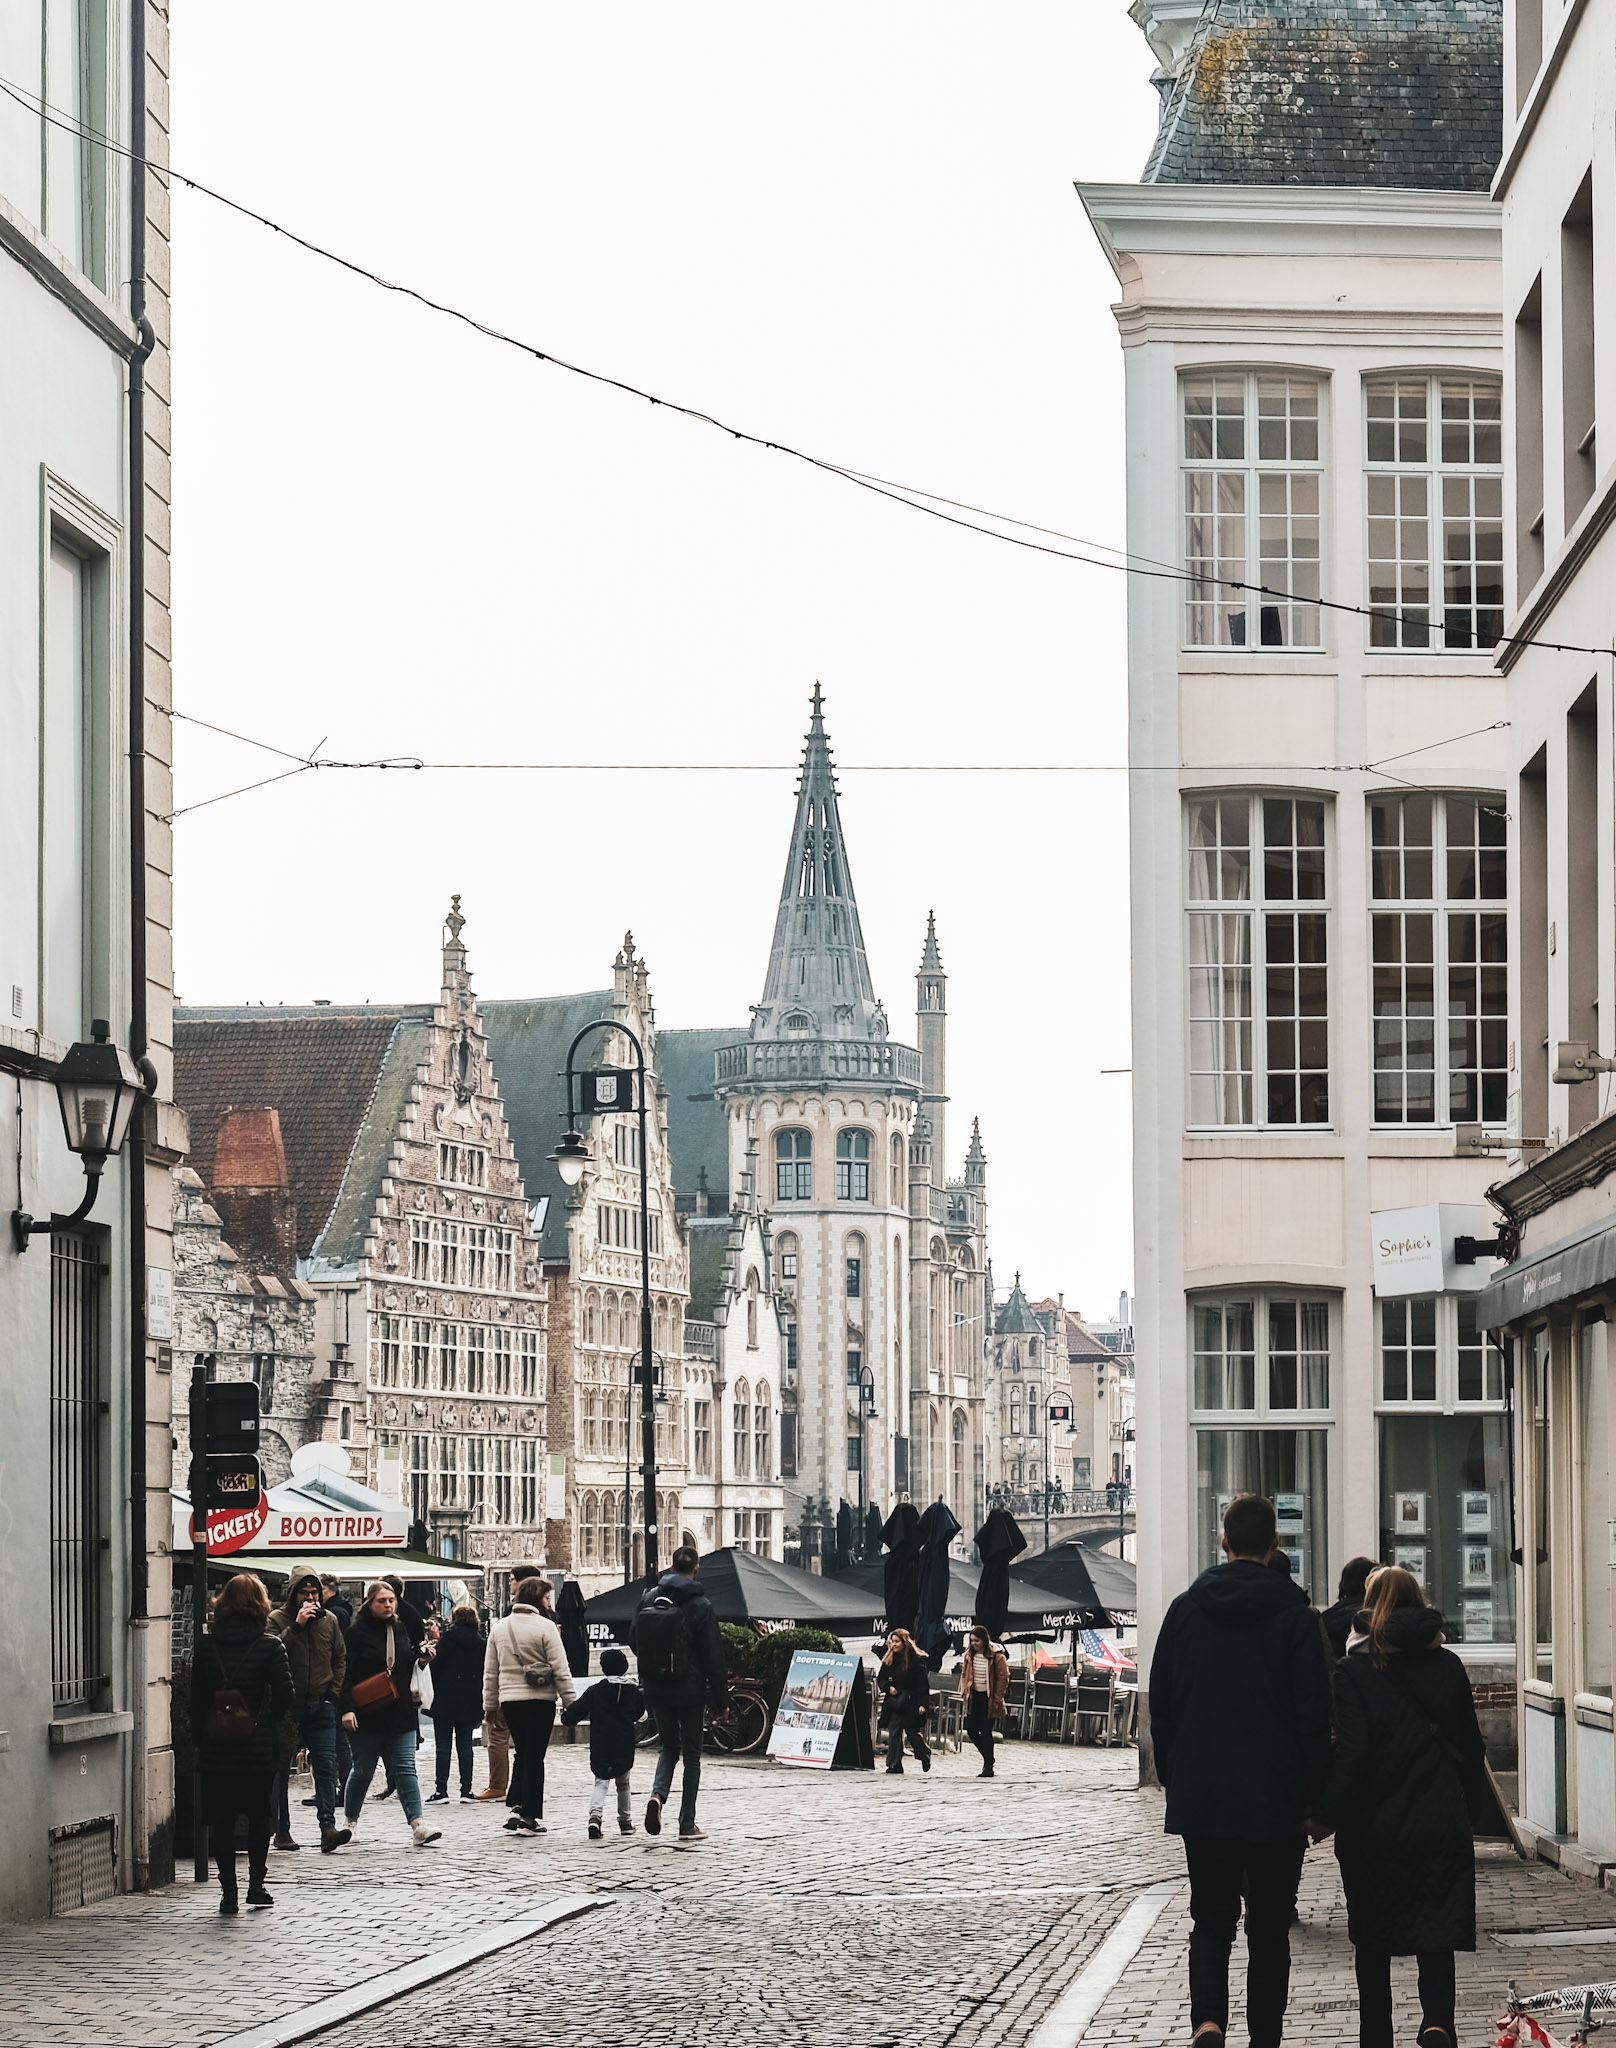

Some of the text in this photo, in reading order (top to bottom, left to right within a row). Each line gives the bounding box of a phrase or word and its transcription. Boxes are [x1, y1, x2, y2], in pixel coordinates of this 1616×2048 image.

[1379, 1234, 1432, 1257] Sophie's
[207, 1509, 262, 1547] ICKETS
[280, 1516, 383, 1538] BOOTTRIPS
[1042, 1610, 1082, 1628] Meraki
[796, 1655, 836, 1666] BOOTTRIPS
